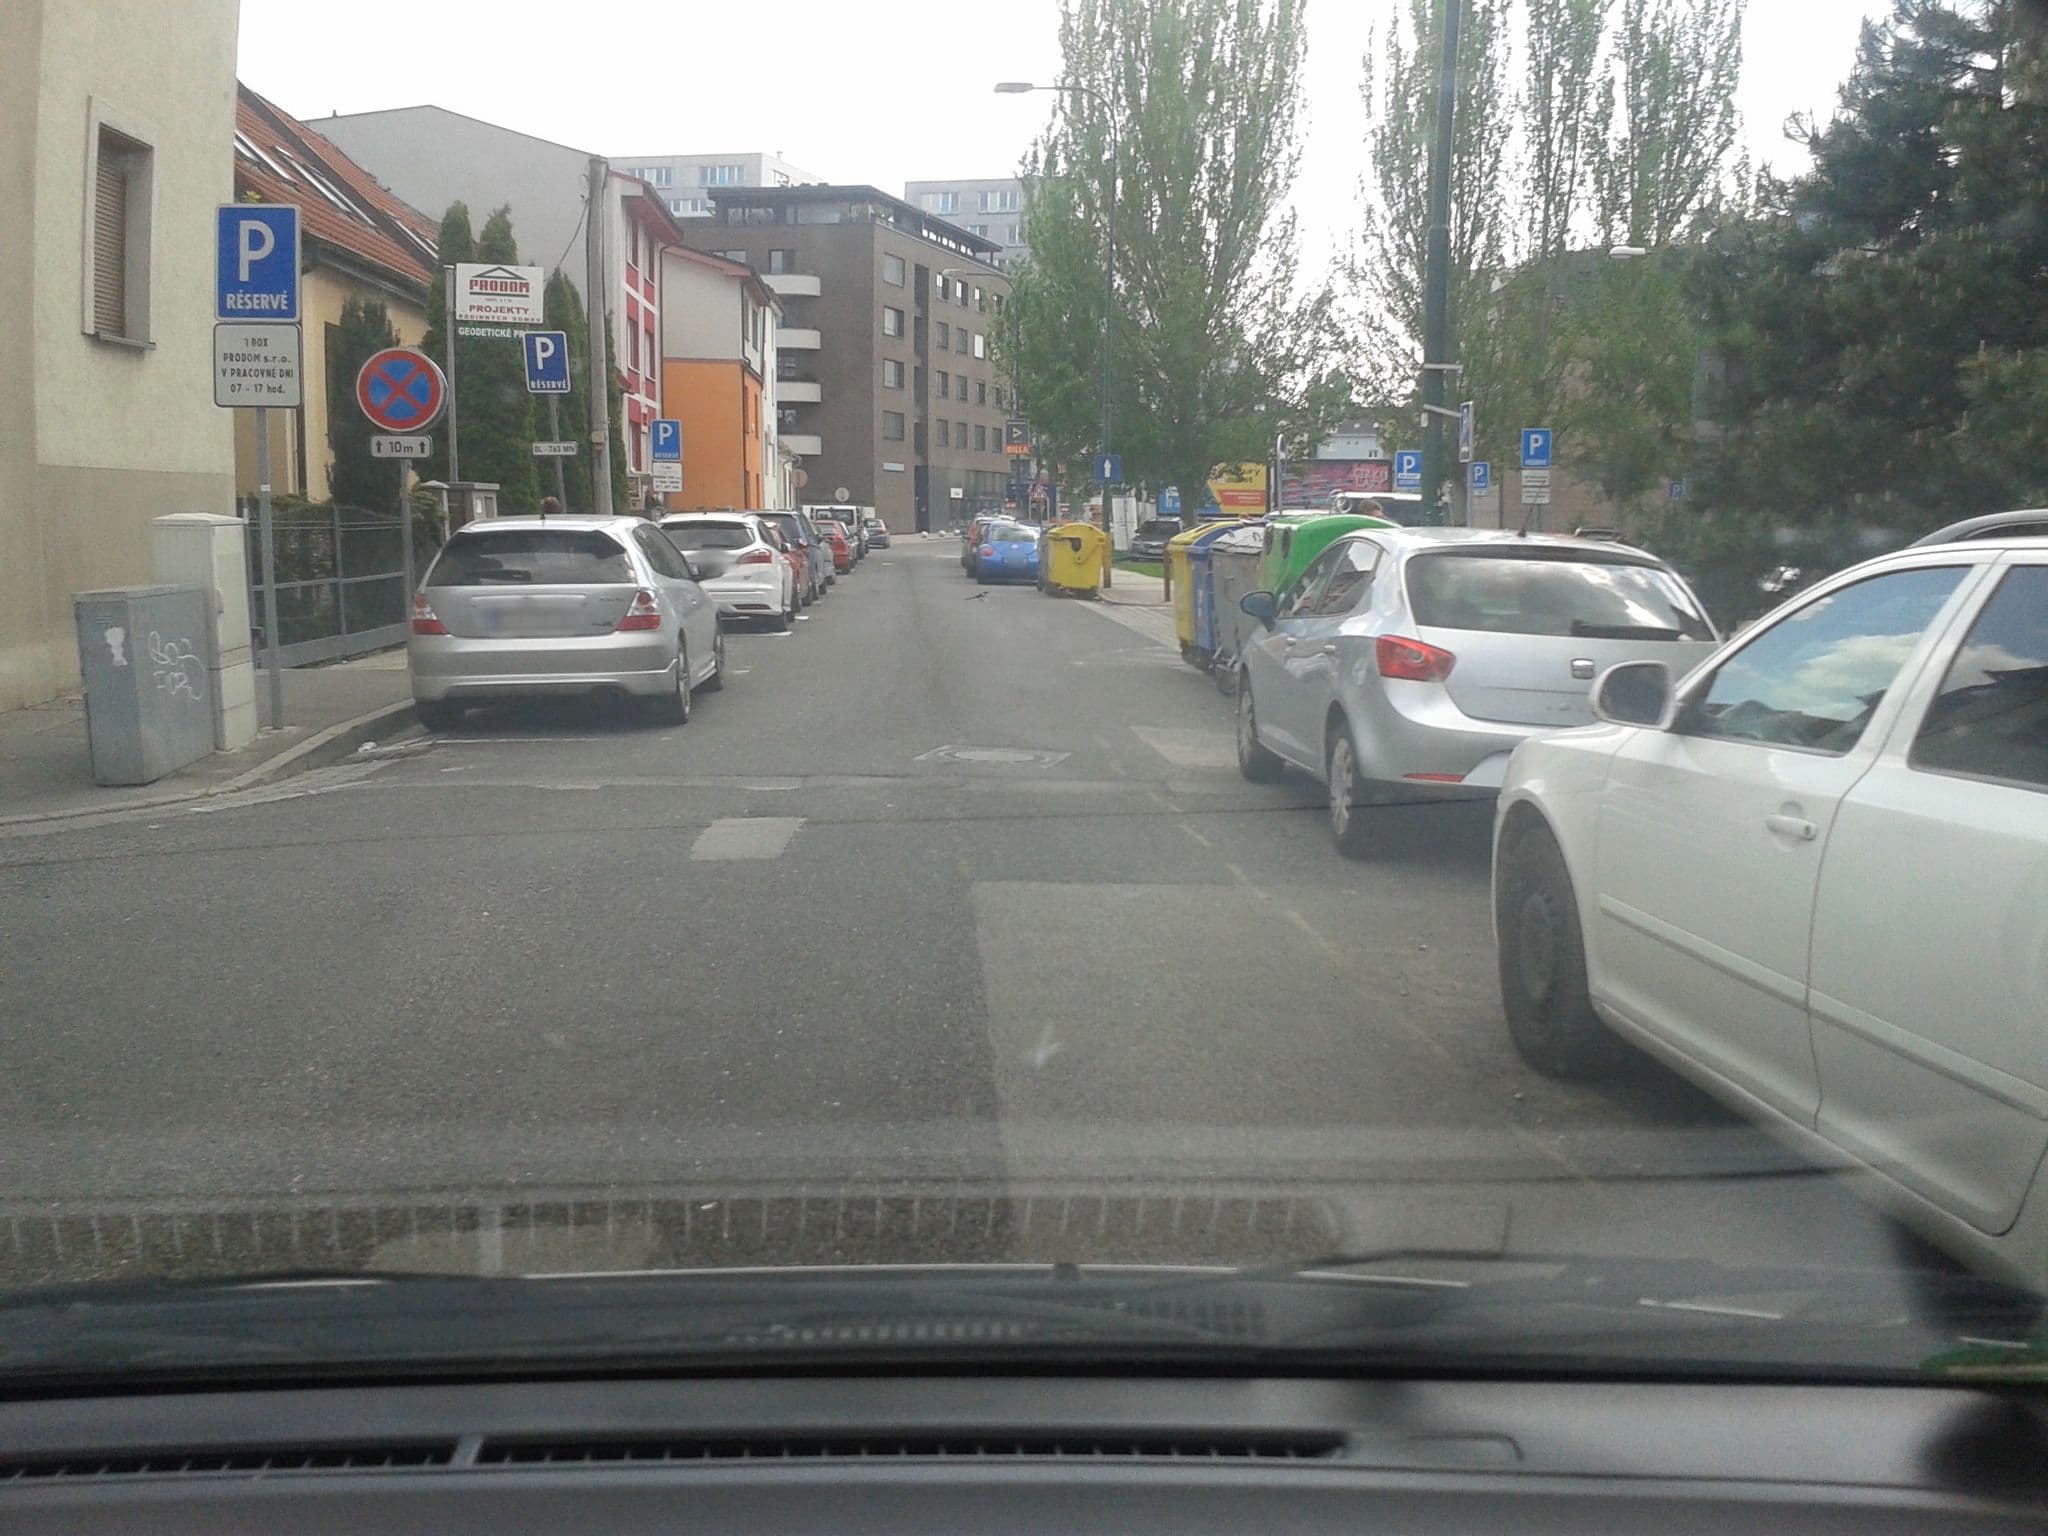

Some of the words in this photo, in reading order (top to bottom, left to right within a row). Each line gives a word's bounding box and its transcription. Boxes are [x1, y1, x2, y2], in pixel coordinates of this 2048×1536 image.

[239, 220, 275, 282] P
[470, 280, 530, 293] PRODOM
[226, 290, 288, 310] RÉSERVÉ
[469, 304, 530, 314] PROJEKTY
[458, 327, 511, 337] GEODETICKÉ
[224, 353, 260, 362] PRODOM
[536, 336, 554, 370] P
[222, 368, 227, 377] V
[279, 369, 294, 378] DNI
[230, 384, 242, 393] 07
[254, 384, 262, 393] 17
[267, 384, 286, 393] hod.
[530, 379, 566, 389] RÉSERVÉ
[659, 423, 673, 445] P
[1529, 436, 1542, 455] P
[1403, 456, 1415, 474] P
[1474, 466, 1483, 481] P
